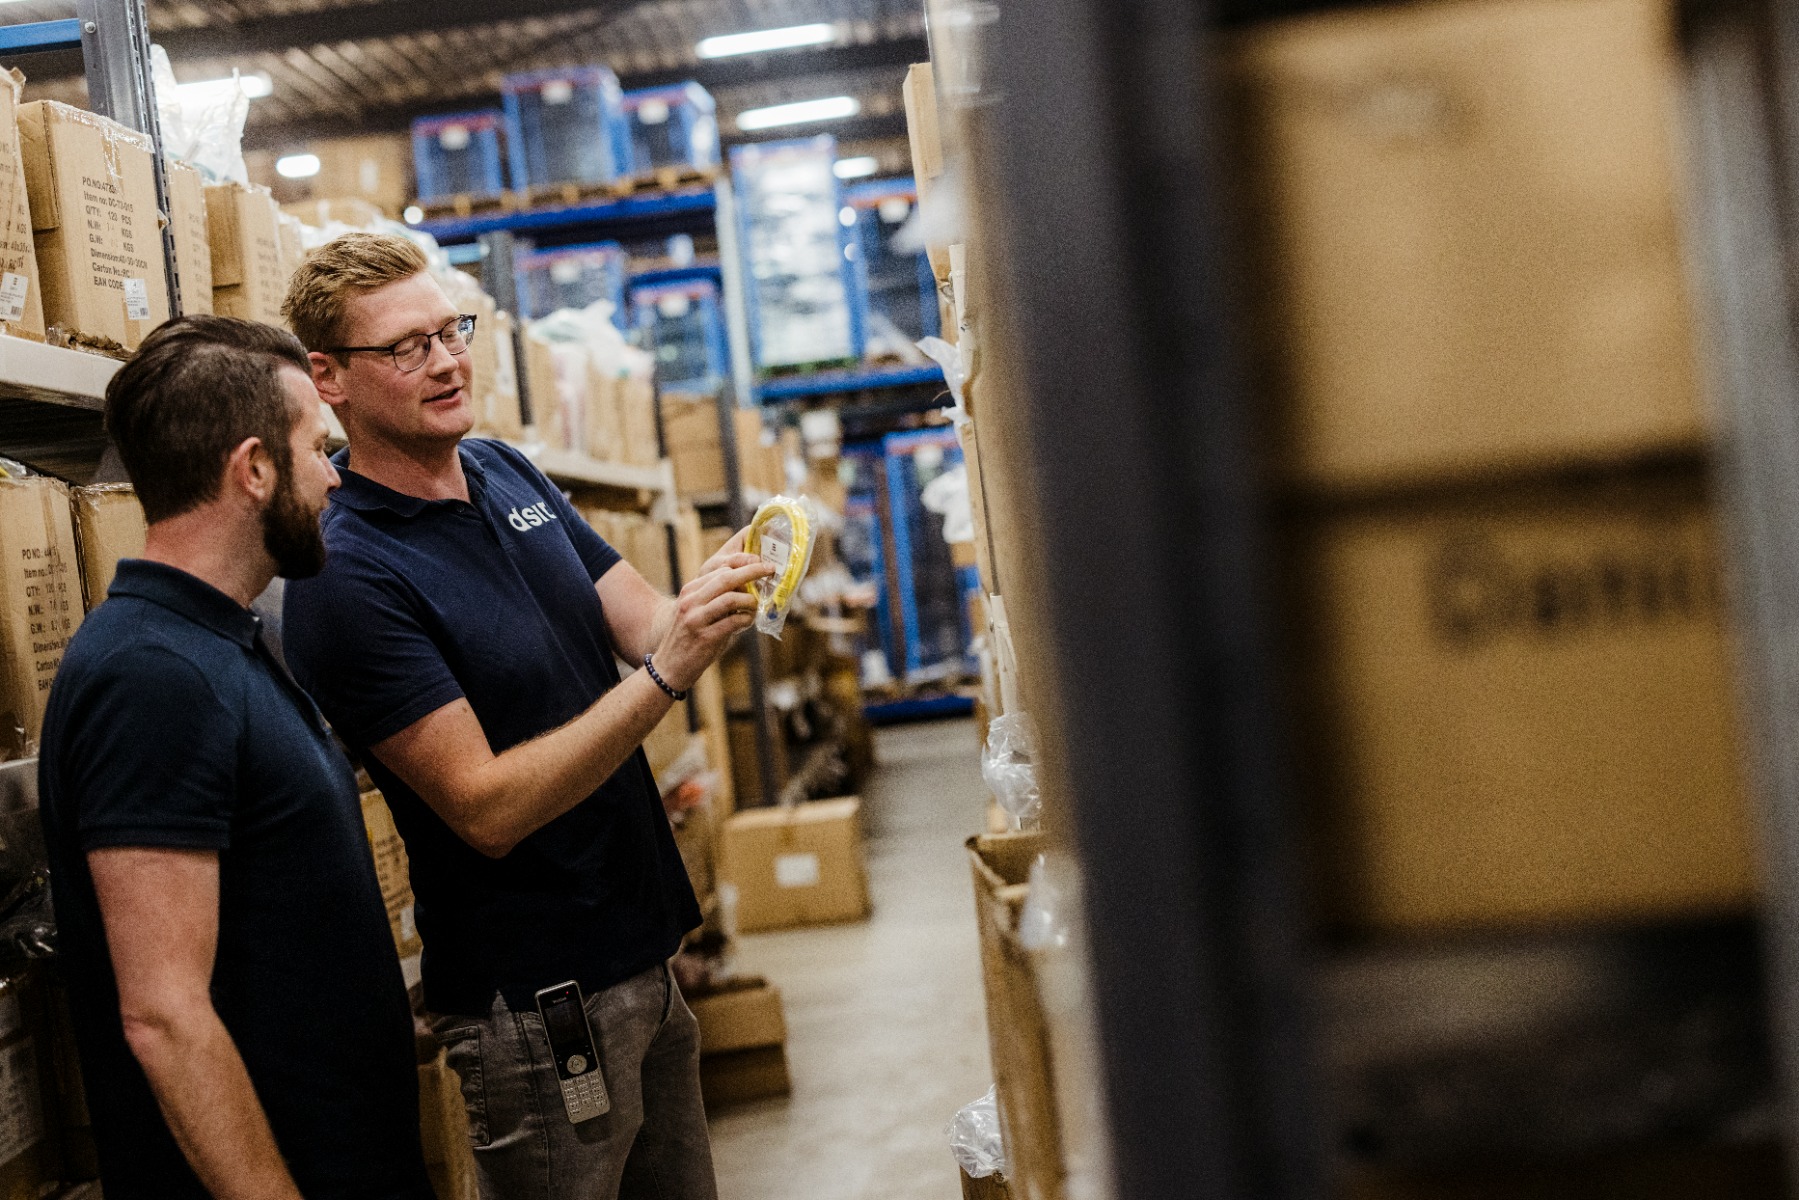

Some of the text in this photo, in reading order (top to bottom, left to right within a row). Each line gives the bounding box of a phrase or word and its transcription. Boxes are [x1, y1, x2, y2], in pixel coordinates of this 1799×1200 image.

[83, 190, 98, 203] Item
[121, 214, 132, 226] PCS
[122, 241, 135, 253] KGS
[92, 262, 112, 275] Carton
[93, 275, 107, 287] EAN
[21, 548, 32, 560] PO
